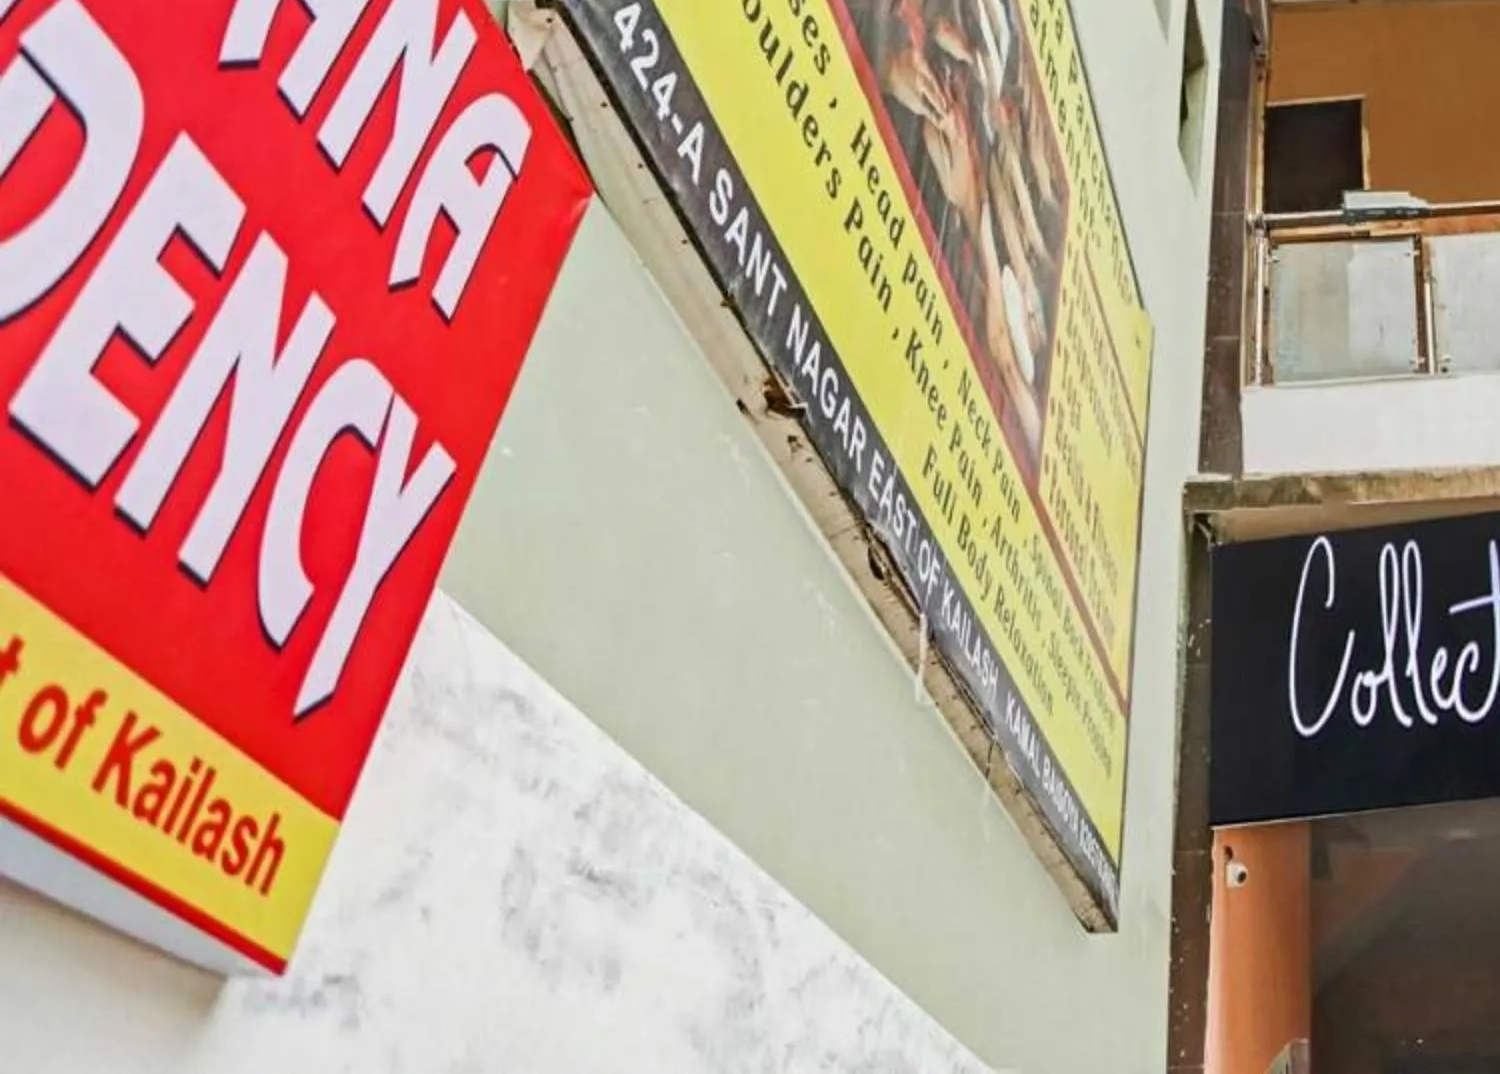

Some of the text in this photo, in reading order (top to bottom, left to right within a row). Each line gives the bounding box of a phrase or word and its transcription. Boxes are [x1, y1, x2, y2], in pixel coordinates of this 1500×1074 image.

[613, 3, 704, 184] 424-A
[709, 168, 787, 316] SANT
[786, 304, 867, 473] NAGAR
[868, 449, 917, 554] EAST
[917, 539, 941, 596] OF
[942, 583, 999, 695] KAILASH
[850, 121, 905, 249] Head
[958, 368, 991, 457] Neck
[904, 328, 947, 430] Knee
[922, 445, 955, 525] Full
[957, 513, 991, 601] Body
[17, 682, 286, 898] of Kailash
